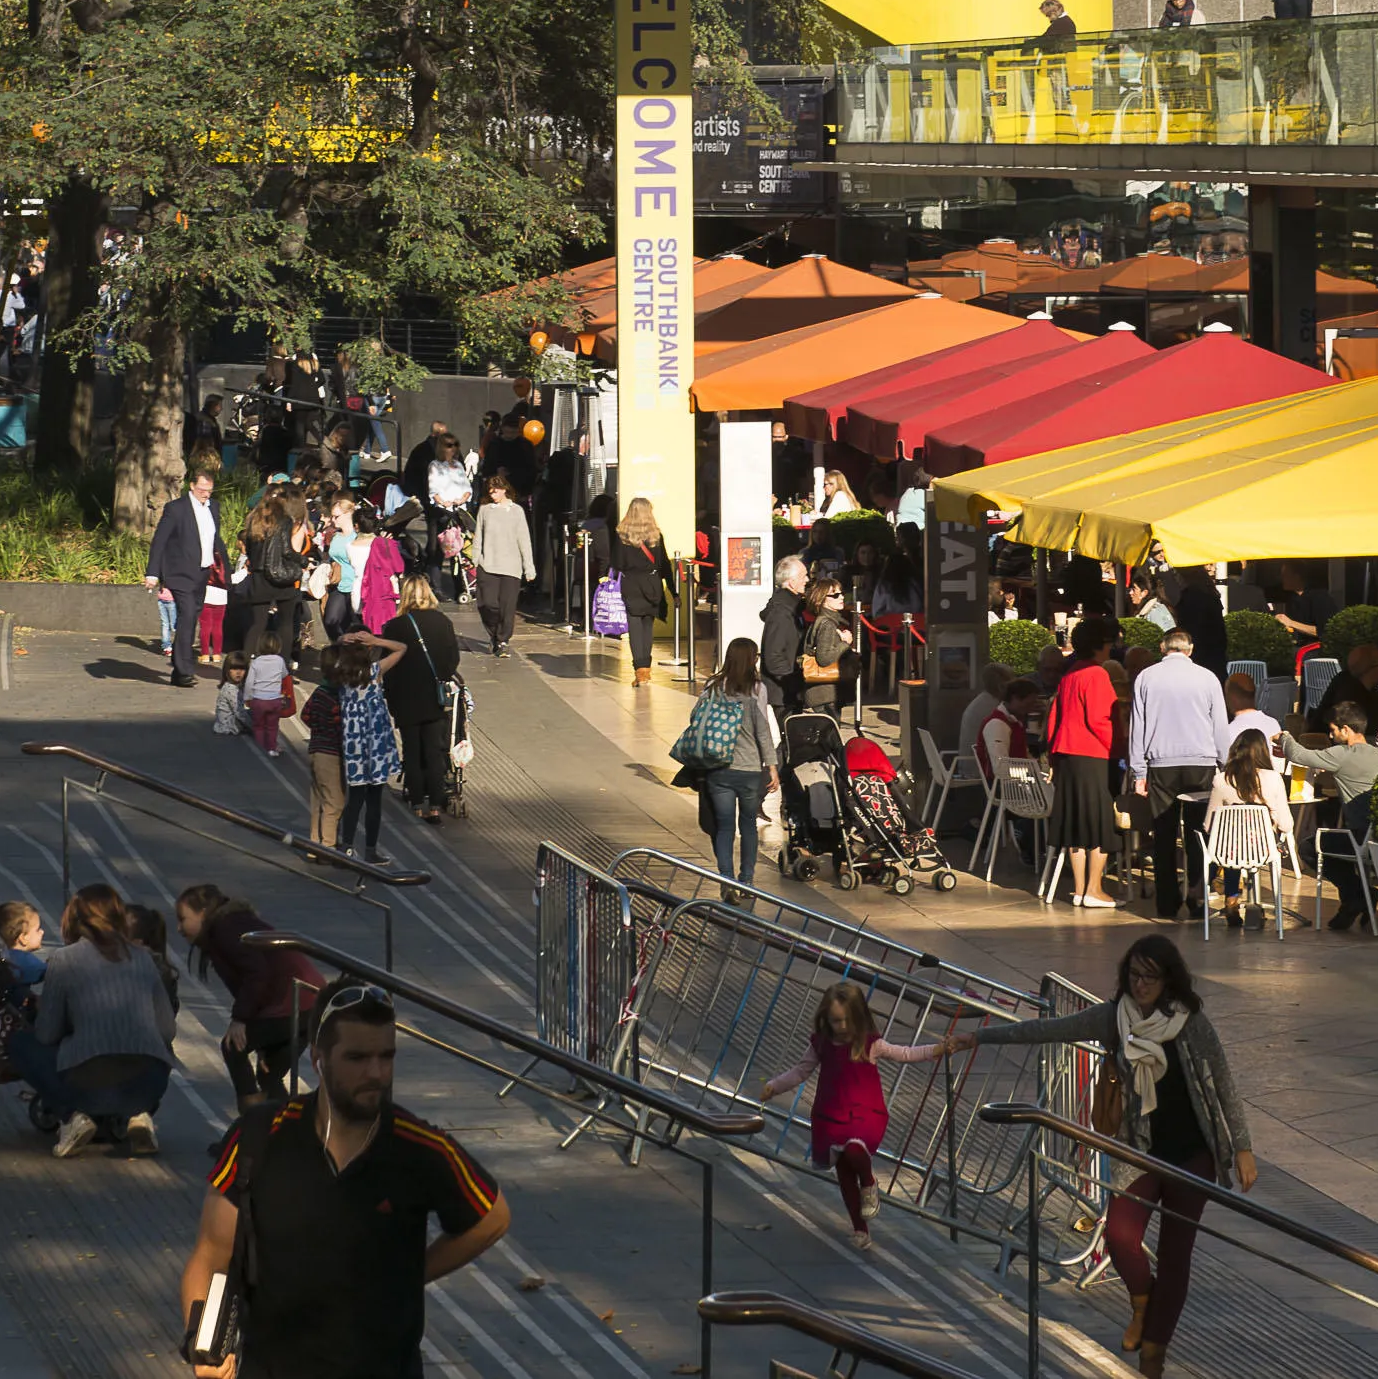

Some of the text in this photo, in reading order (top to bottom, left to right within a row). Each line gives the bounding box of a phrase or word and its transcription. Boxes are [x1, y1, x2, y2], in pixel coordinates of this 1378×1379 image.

[693, 114, 741, 137] artists
[692, 140, 731, 155] nd reality
[759, 150, 788, 160] HAYWARD
[759, 180, 792, 193] CENTRE
[633, 238, 654, 332] CENTRE
[658, 238, 679, 389] SOUTHBANK
